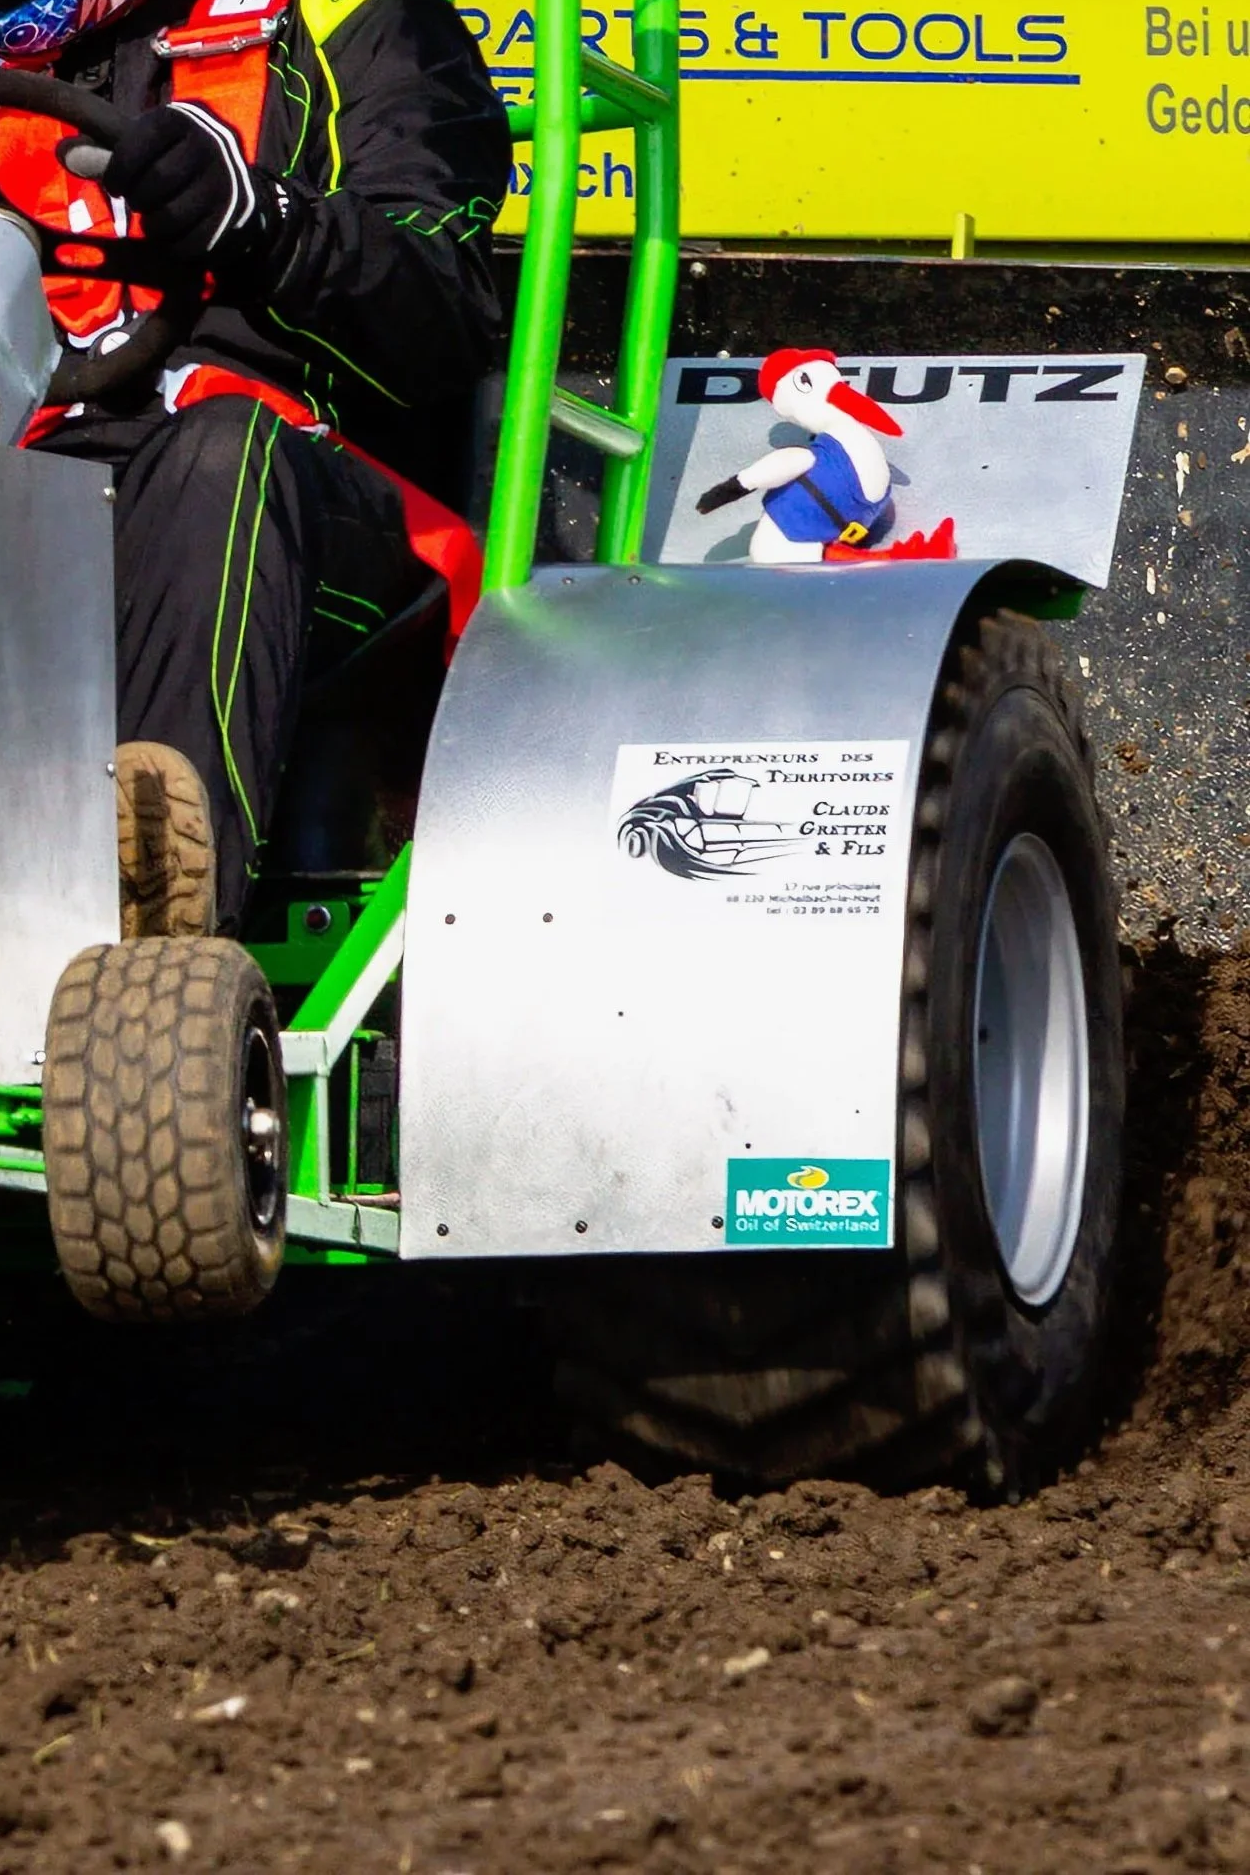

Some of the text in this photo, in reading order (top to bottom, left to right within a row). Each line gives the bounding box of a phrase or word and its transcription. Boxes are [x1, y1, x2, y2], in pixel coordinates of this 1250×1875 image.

[734, 11, 779, 59] &
[802, 11, 1068, 63] TOOLS
[1146, 6, 1209, 56] Bei
[675, 364, 1125, 405] DUTZ
[814, 842, 831, 856] &
[735, 1189, 881, 1217] MOTOREX
[735, 1217, 880, 1232] Oil of Switzerland
